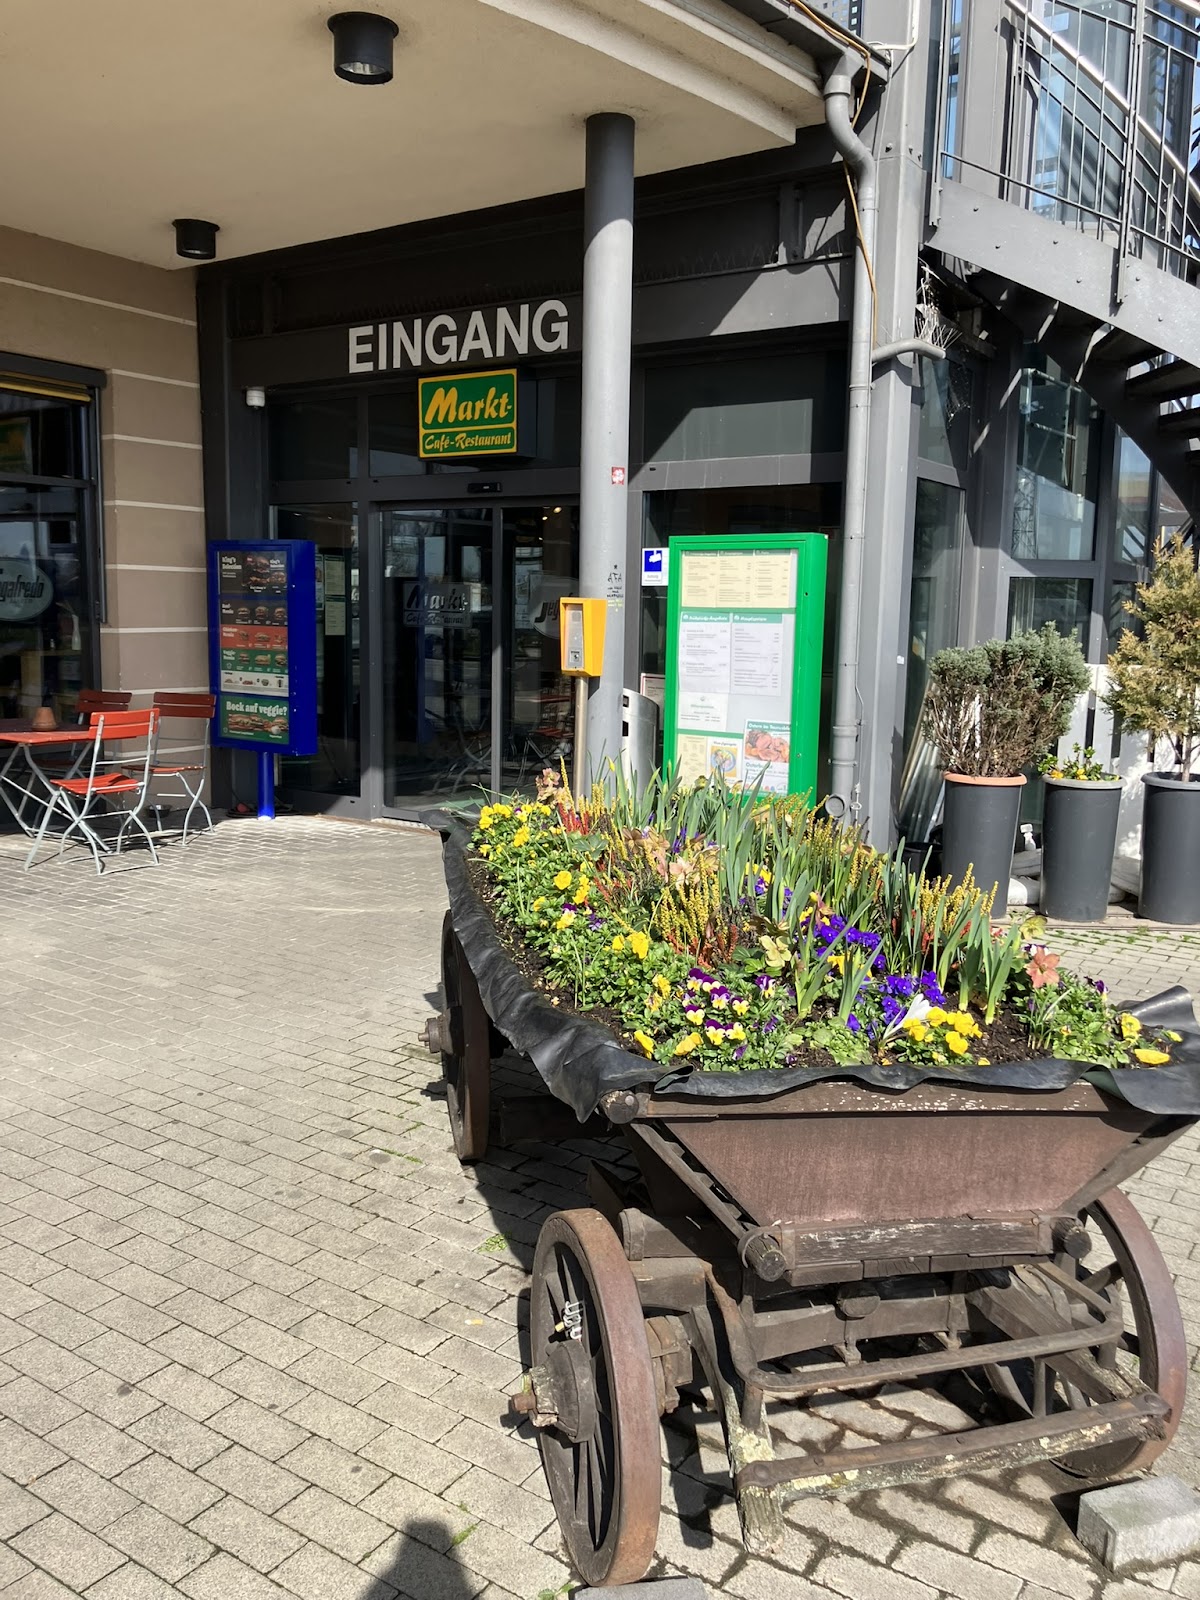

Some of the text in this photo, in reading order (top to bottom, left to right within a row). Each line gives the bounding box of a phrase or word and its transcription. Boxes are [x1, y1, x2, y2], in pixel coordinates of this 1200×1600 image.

[348, 299, 569, 374] EINGANG
[424, 386, 513, 425] Markt-
[424, 431, 512, 452] Café-Restaurant
[226, 701, 288, 717] Bock auf veggie?
